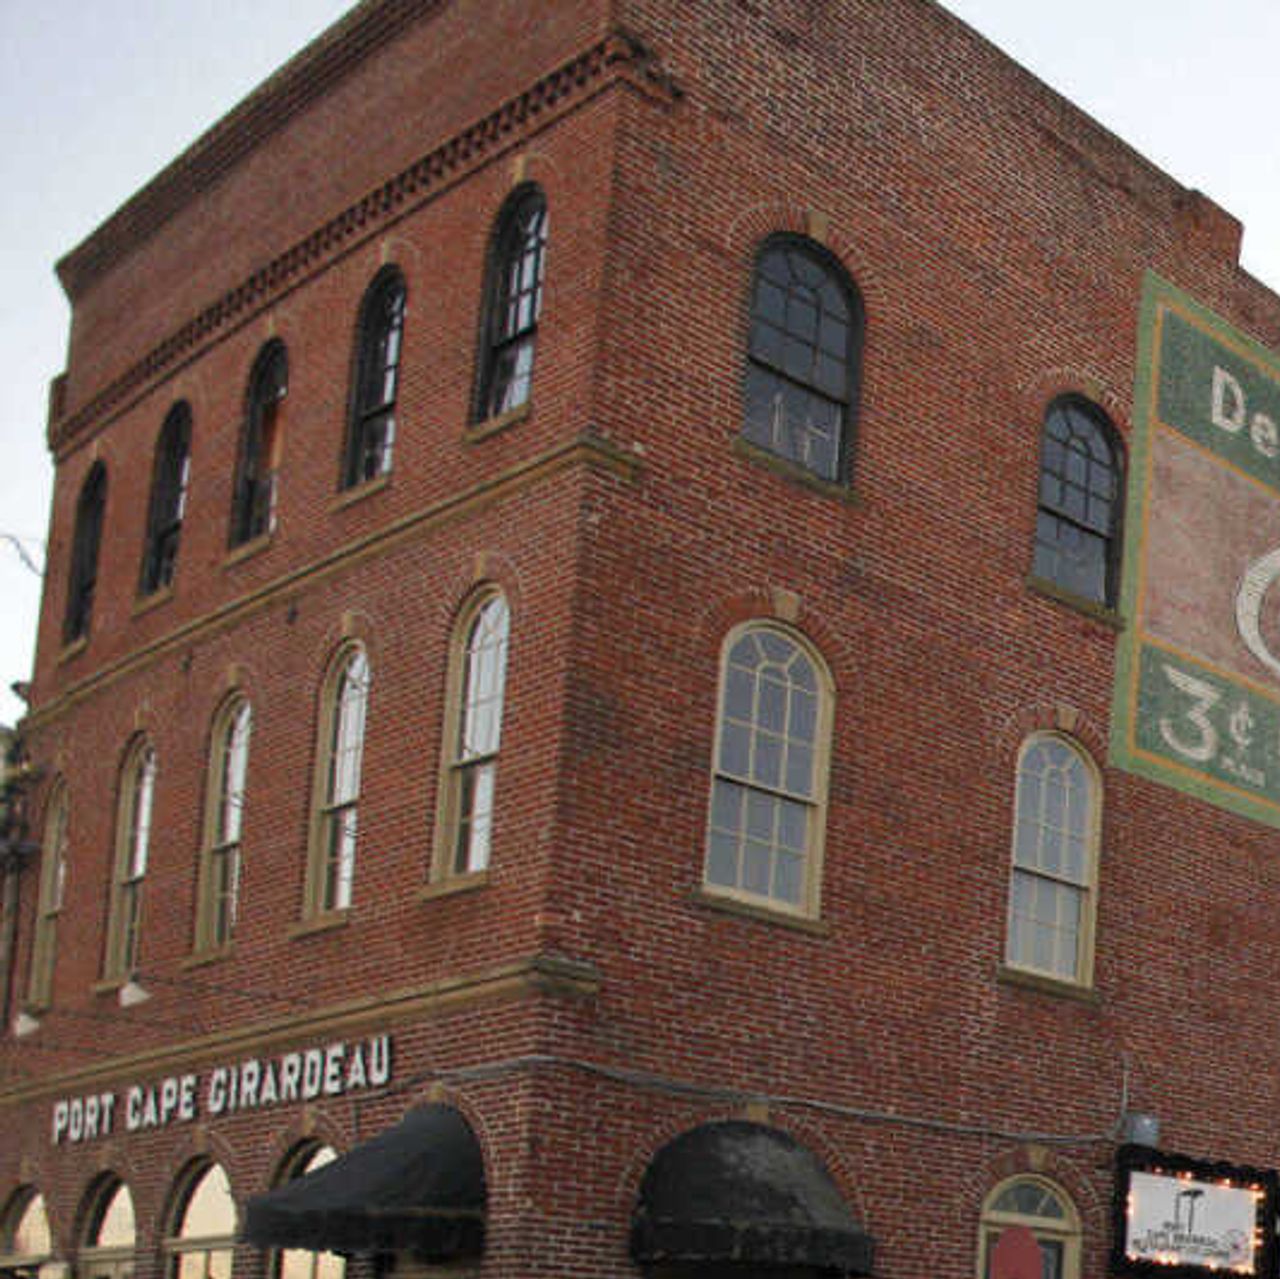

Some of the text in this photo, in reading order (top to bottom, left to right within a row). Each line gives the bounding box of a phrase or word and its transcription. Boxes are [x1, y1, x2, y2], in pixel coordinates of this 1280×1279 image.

[52, 1034, 391, 1145] PORT CAPE GIRARDEAU
